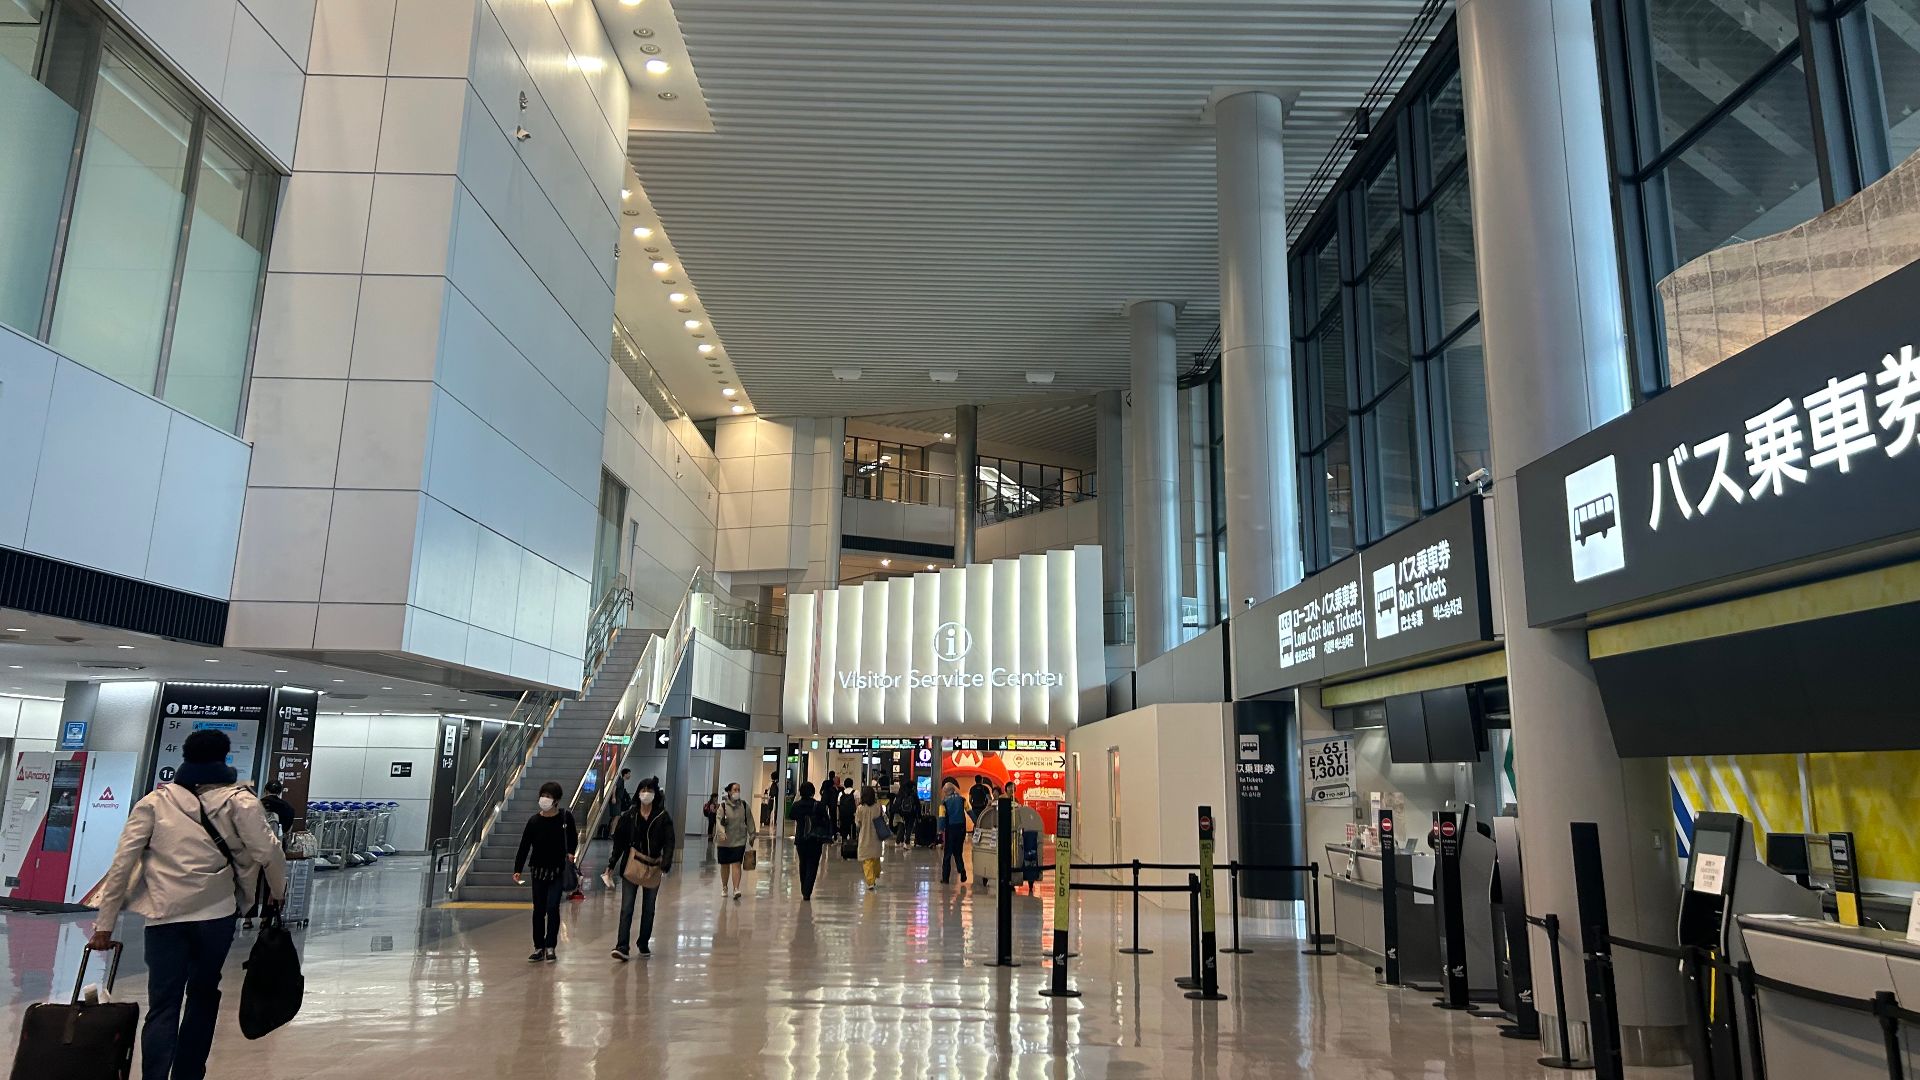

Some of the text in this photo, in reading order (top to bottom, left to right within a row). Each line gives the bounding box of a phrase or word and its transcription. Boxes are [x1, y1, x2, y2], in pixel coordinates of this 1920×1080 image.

[1399, 539, 1451, 585] バス乗車券
[1399, 576, 1447, 611] Bus Tickets
[1293, 581, 1358, 628] ローコスト バス乗車券
[1294, 608, 1362, 647] Low Cost Bus Tickets
[839, 667, 1065, 688] Visitor Service Center
[169, 721, 181, 729] 5F
[166, 744, 178, 752] 4F
[1323, 743, 1339, 754] 65
[162, 769, 174, 778] 1F
[1058, 840, 1069, 848] 入口
